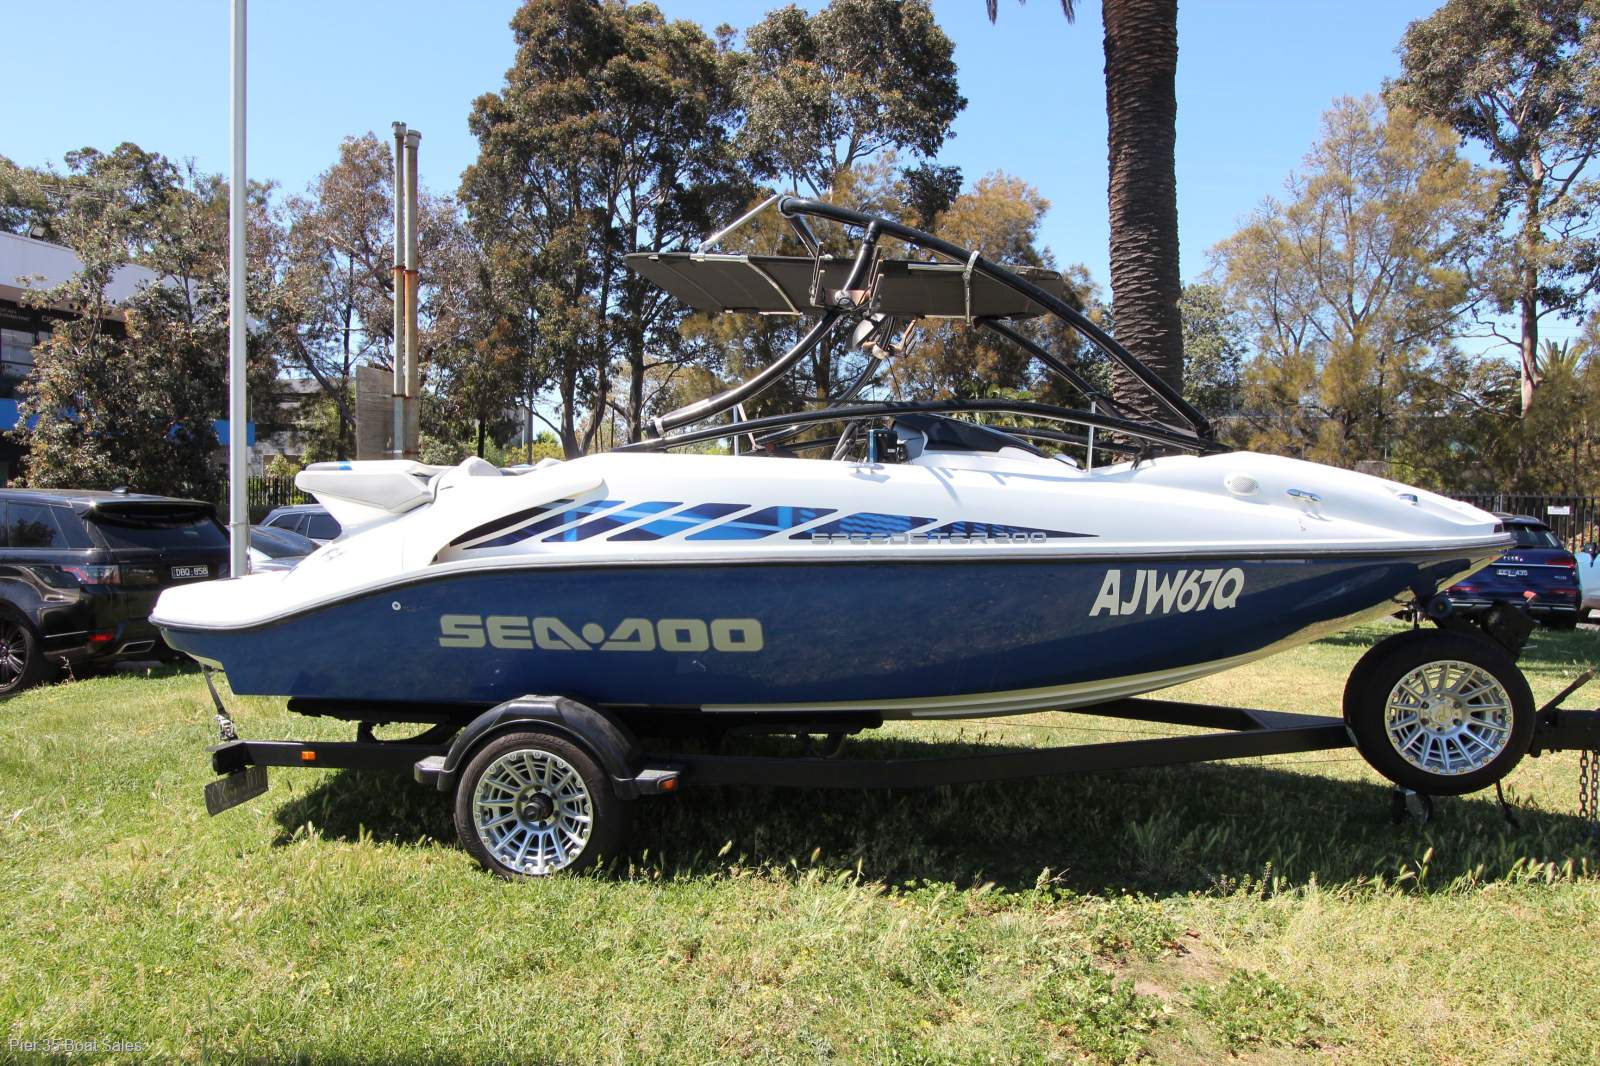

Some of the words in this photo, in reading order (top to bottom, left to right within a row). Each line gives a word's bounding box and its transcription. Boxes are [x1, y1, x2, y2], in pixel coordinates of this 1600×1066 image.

[811, 532, 988, 545] SPEEDSTER
[994, 531, 1047, 544] 200
[1088, 567, 1245, 617] AJW67Q
